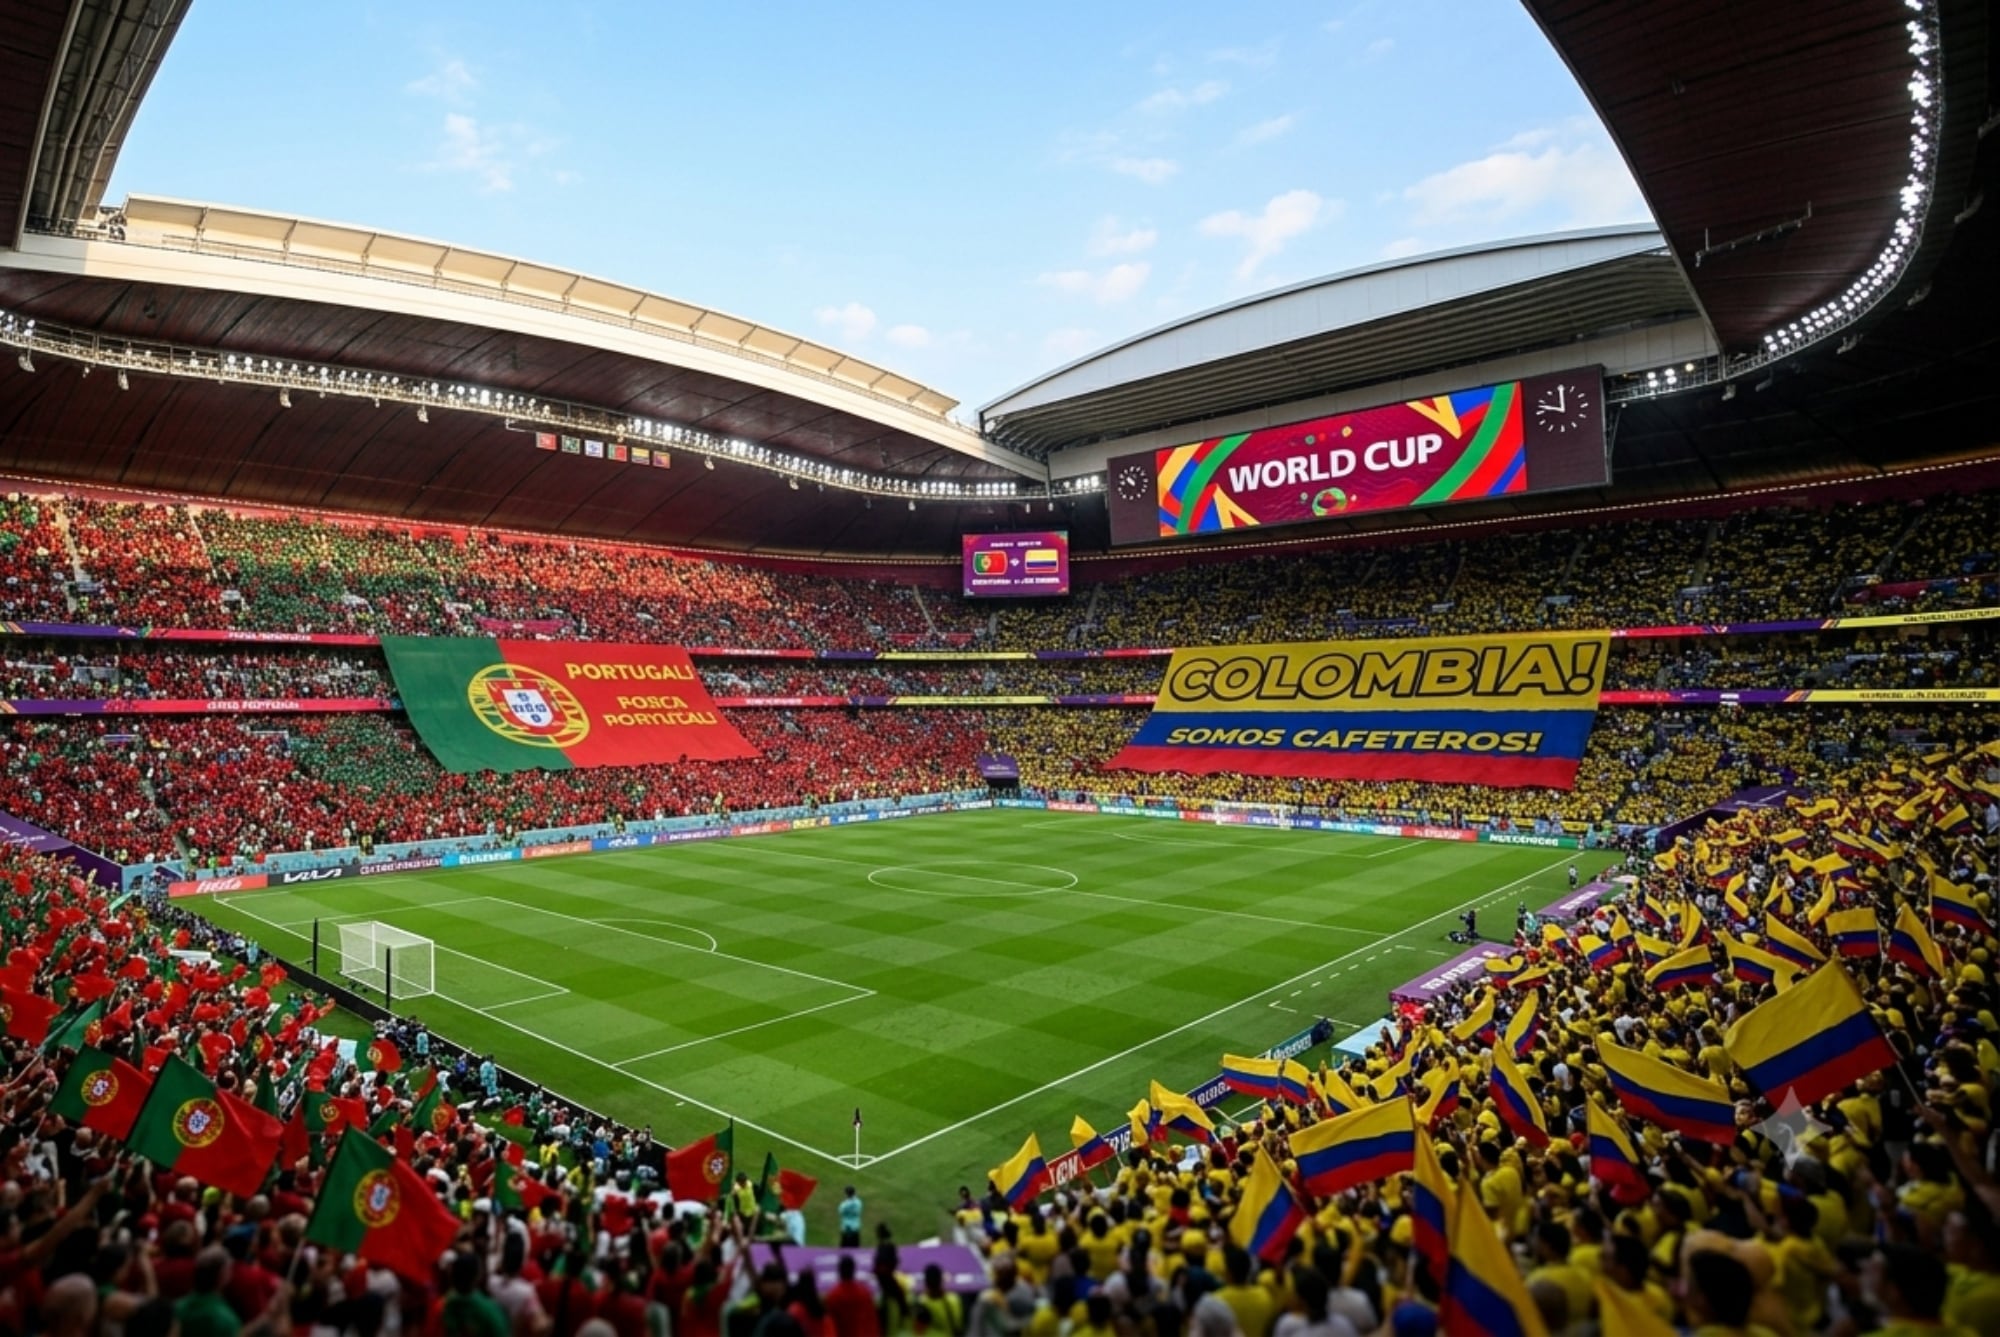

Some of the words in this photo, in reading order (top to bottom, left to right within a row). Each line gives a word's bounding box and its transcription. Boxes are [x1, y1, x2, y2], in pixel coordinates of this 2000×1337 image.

[1228, 449, 1356, 493] WORLD
[1364, 433, 1443, 471] CUP
[1169, 642, 1602, 701] COLOMBIA!
[1166, 727, 1285, 746] SOMOS
[1292, 728, 1543, 752] CAFETEROS!
